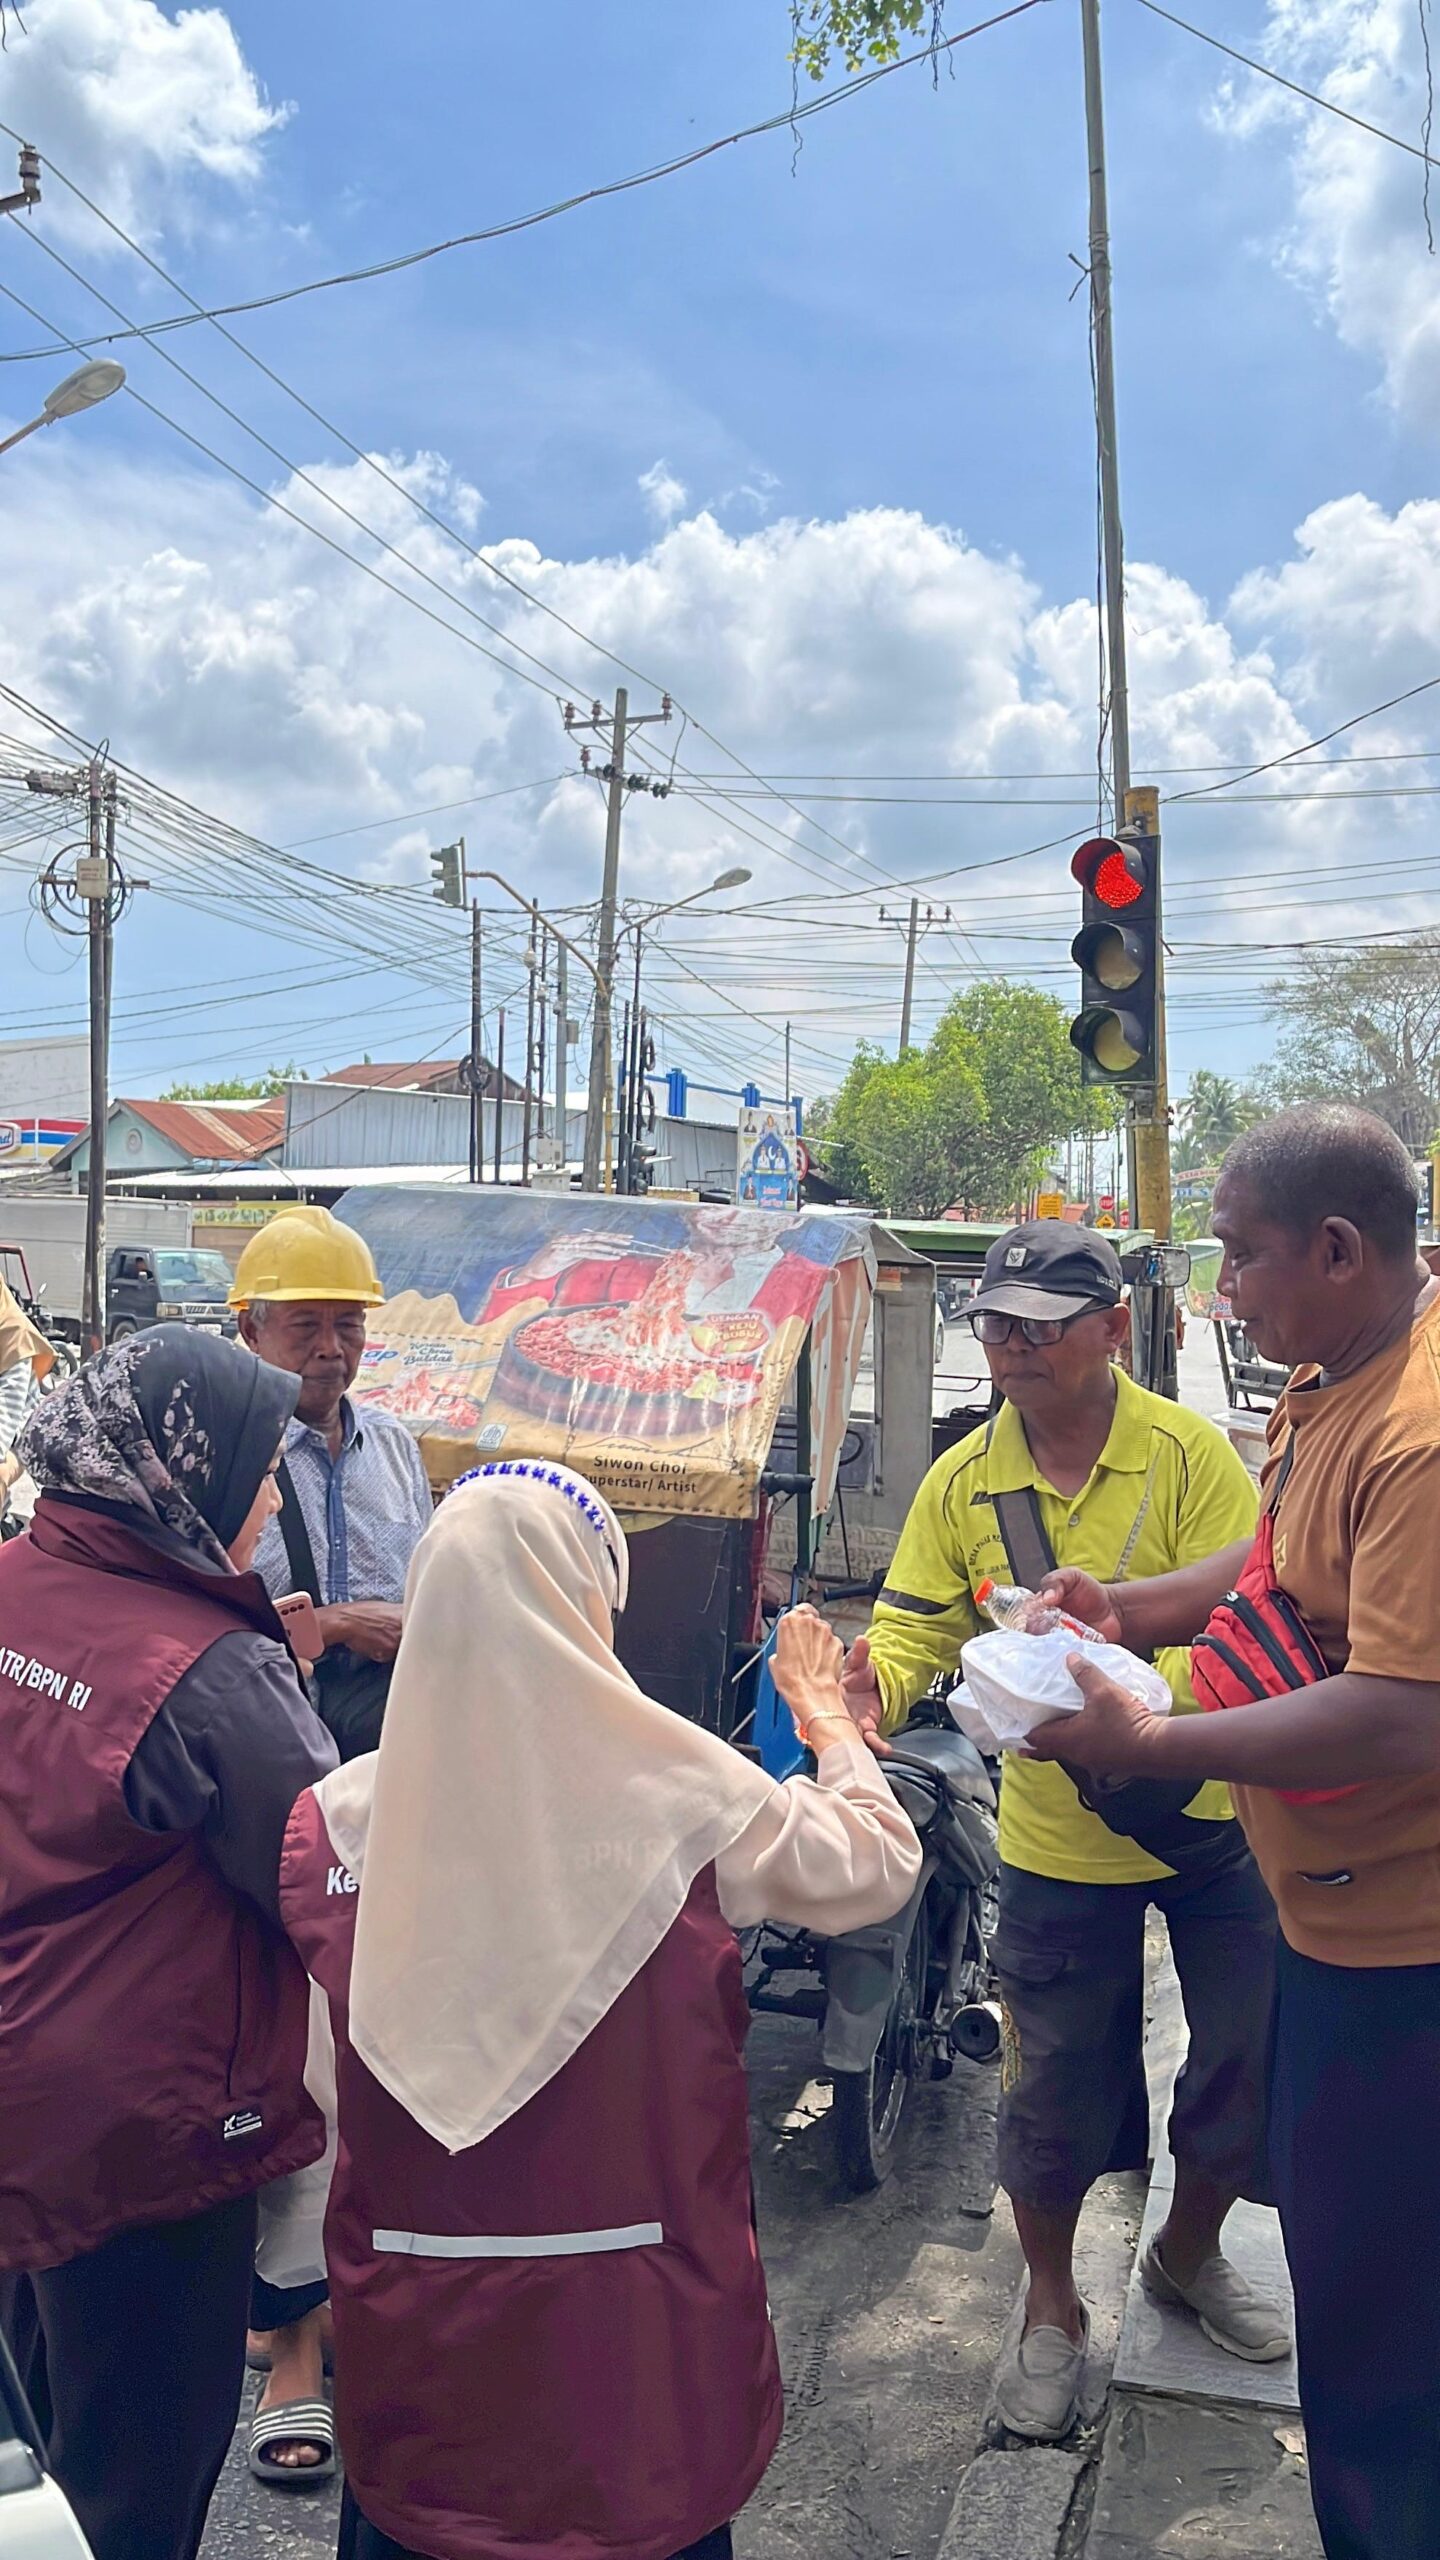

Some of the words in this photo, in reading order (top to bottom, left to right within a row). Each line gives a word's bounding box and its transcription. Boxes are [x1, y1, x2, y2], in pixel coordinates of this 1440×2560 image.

[594, 1455, 644, 1471] Siwon
[649, 1460, 688, 1475] Choi
[657, 1479, 697, 1493] Artist
[67, 1680, 93, 1711] RI
